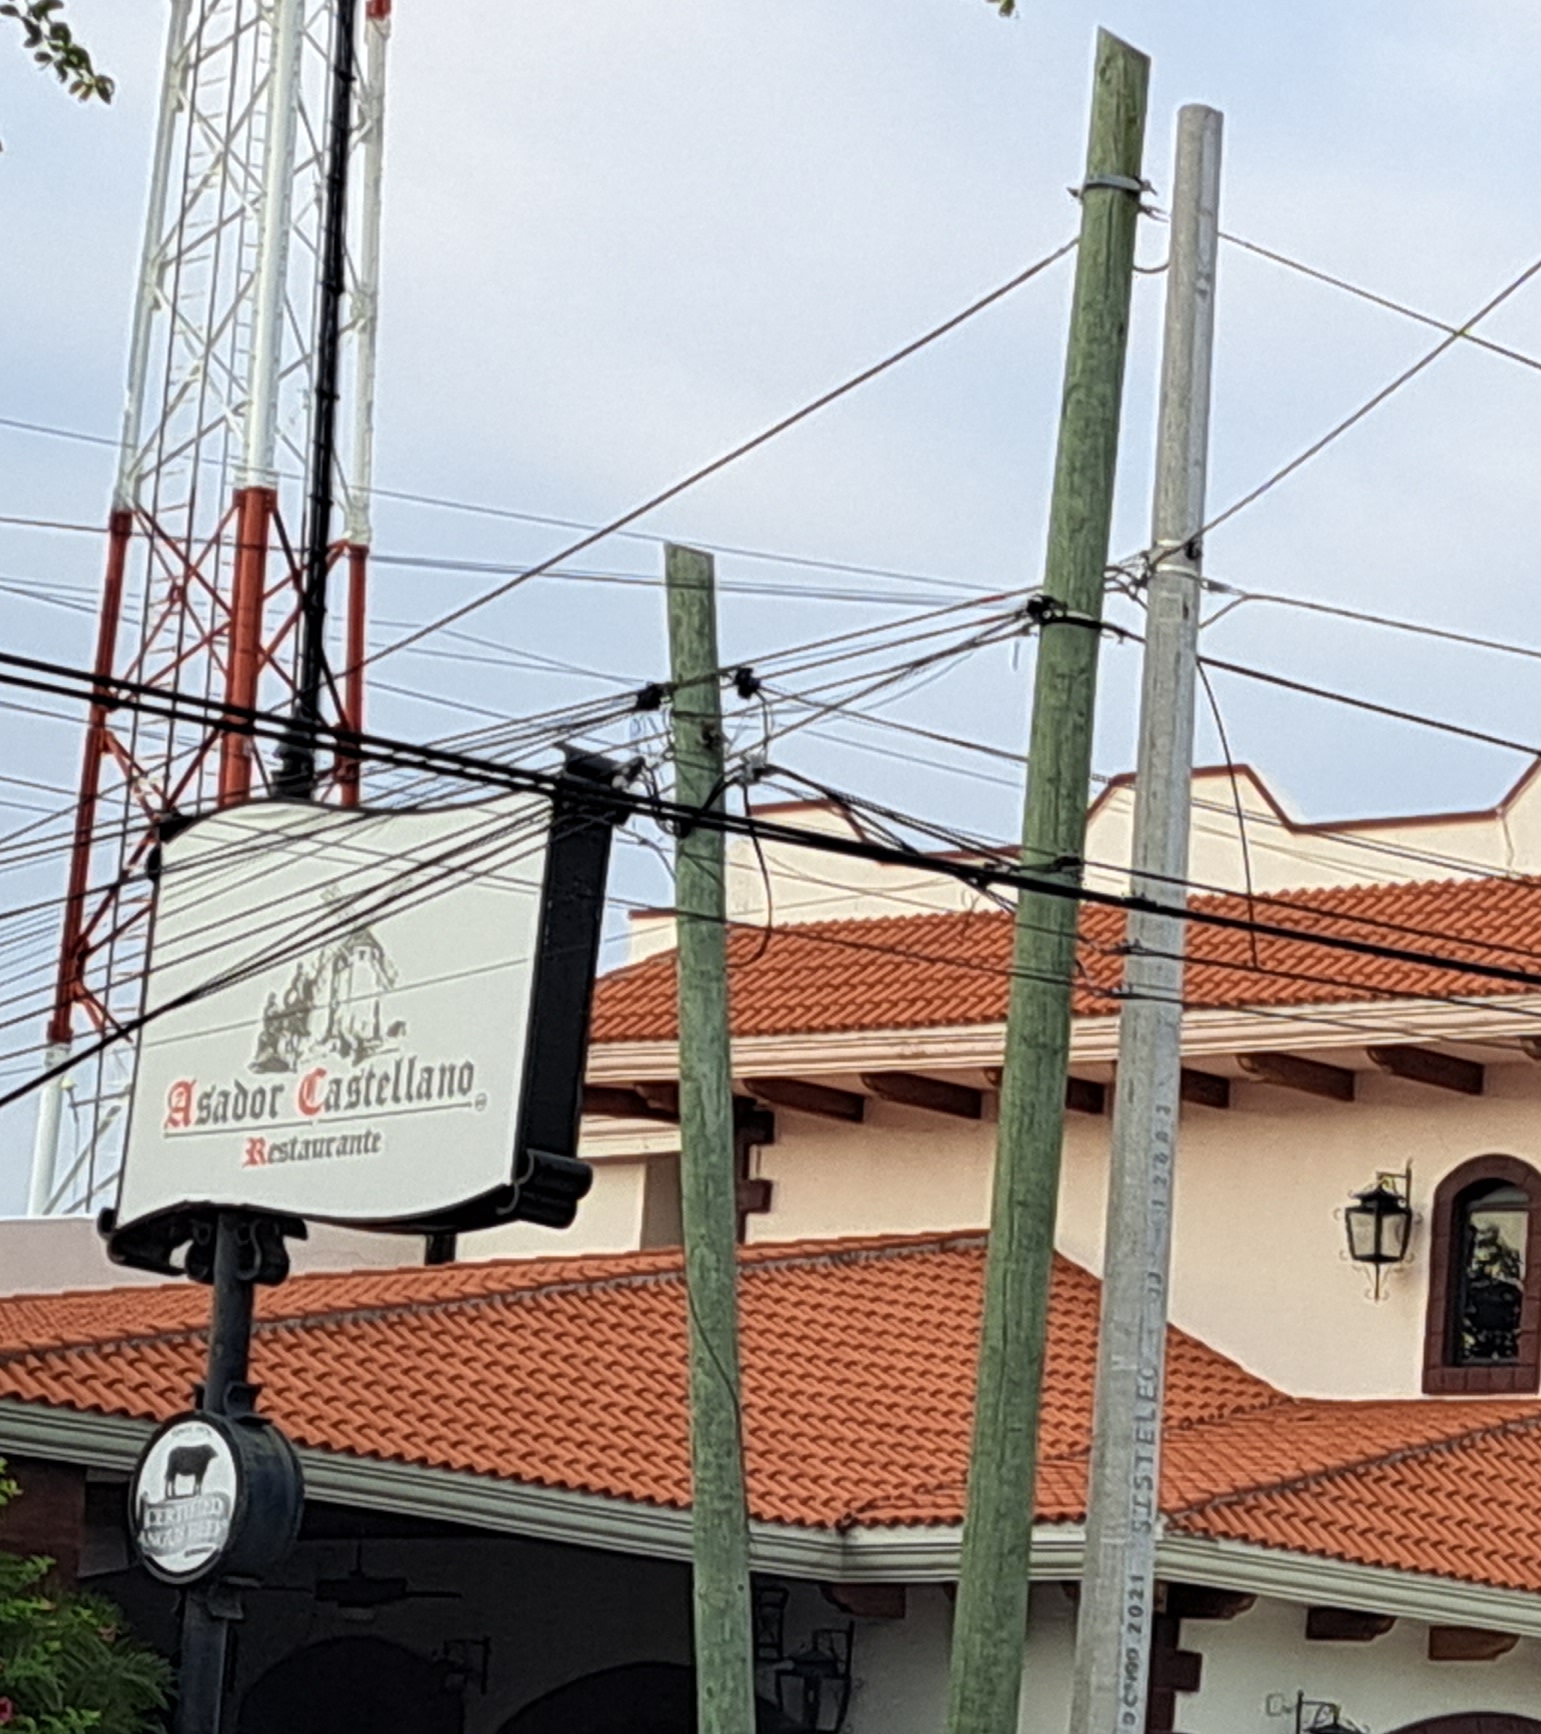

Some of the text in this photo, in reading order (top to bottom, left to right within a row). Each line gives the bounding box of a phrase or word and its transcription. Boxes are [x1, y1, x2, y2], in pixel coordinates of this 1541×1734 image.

[164, 1055, 475, 1129] Asador Castellano
[242, 1129, 382, 1168] Restaurante
[1127, 1575, 1144, 1634] 2021
